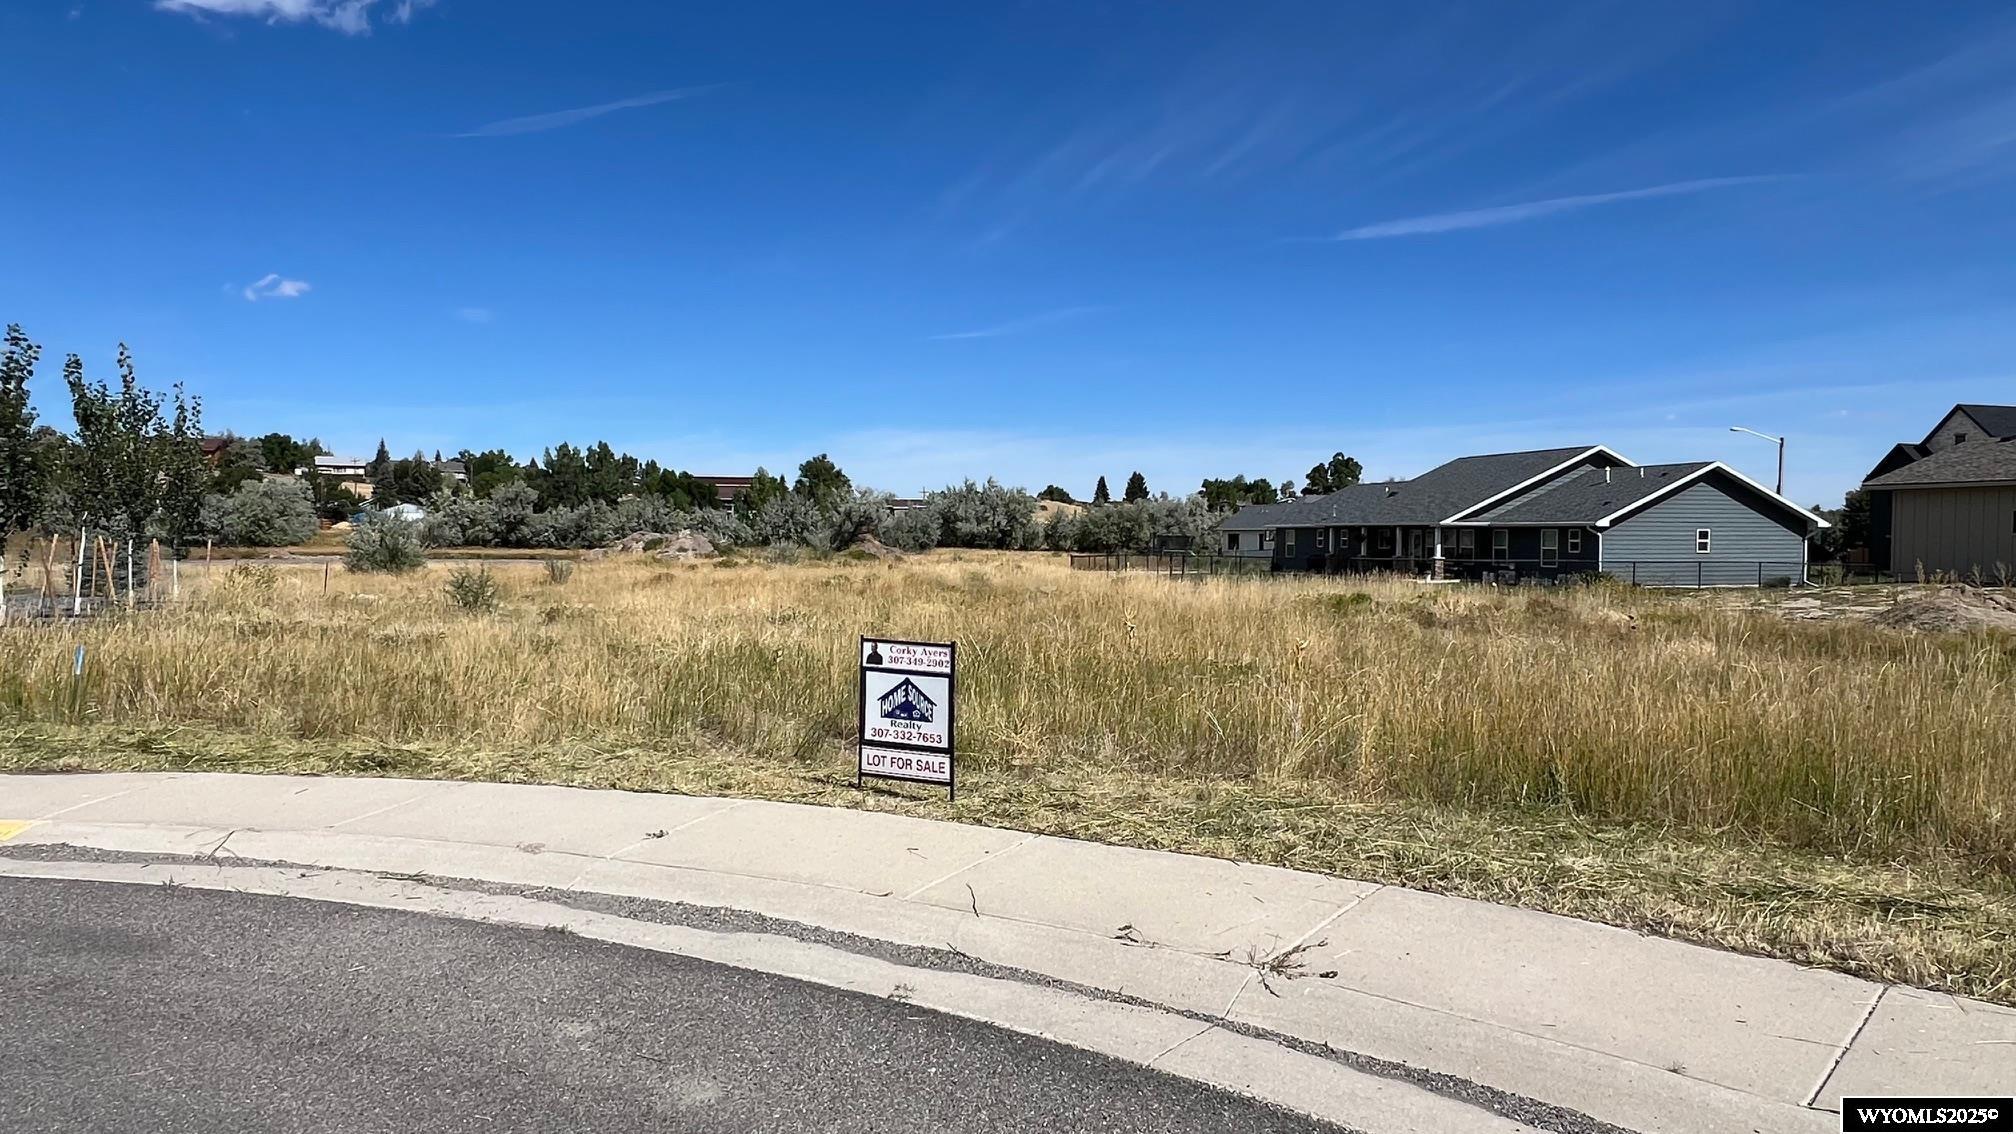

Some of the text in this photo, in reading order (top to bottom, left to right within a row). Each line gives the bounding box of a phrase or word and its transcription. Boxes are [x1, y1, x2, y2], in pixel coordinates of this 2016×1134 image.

[890, 645, 948, 658] Corky Ayers
[881, 684, 933, 722] HOME SOURCE
[890, 720, 922, 731] Realty
[871, 727, 942, 744] 307-332-7653
[867, 753, 946, 774] LOT FOR SALE
